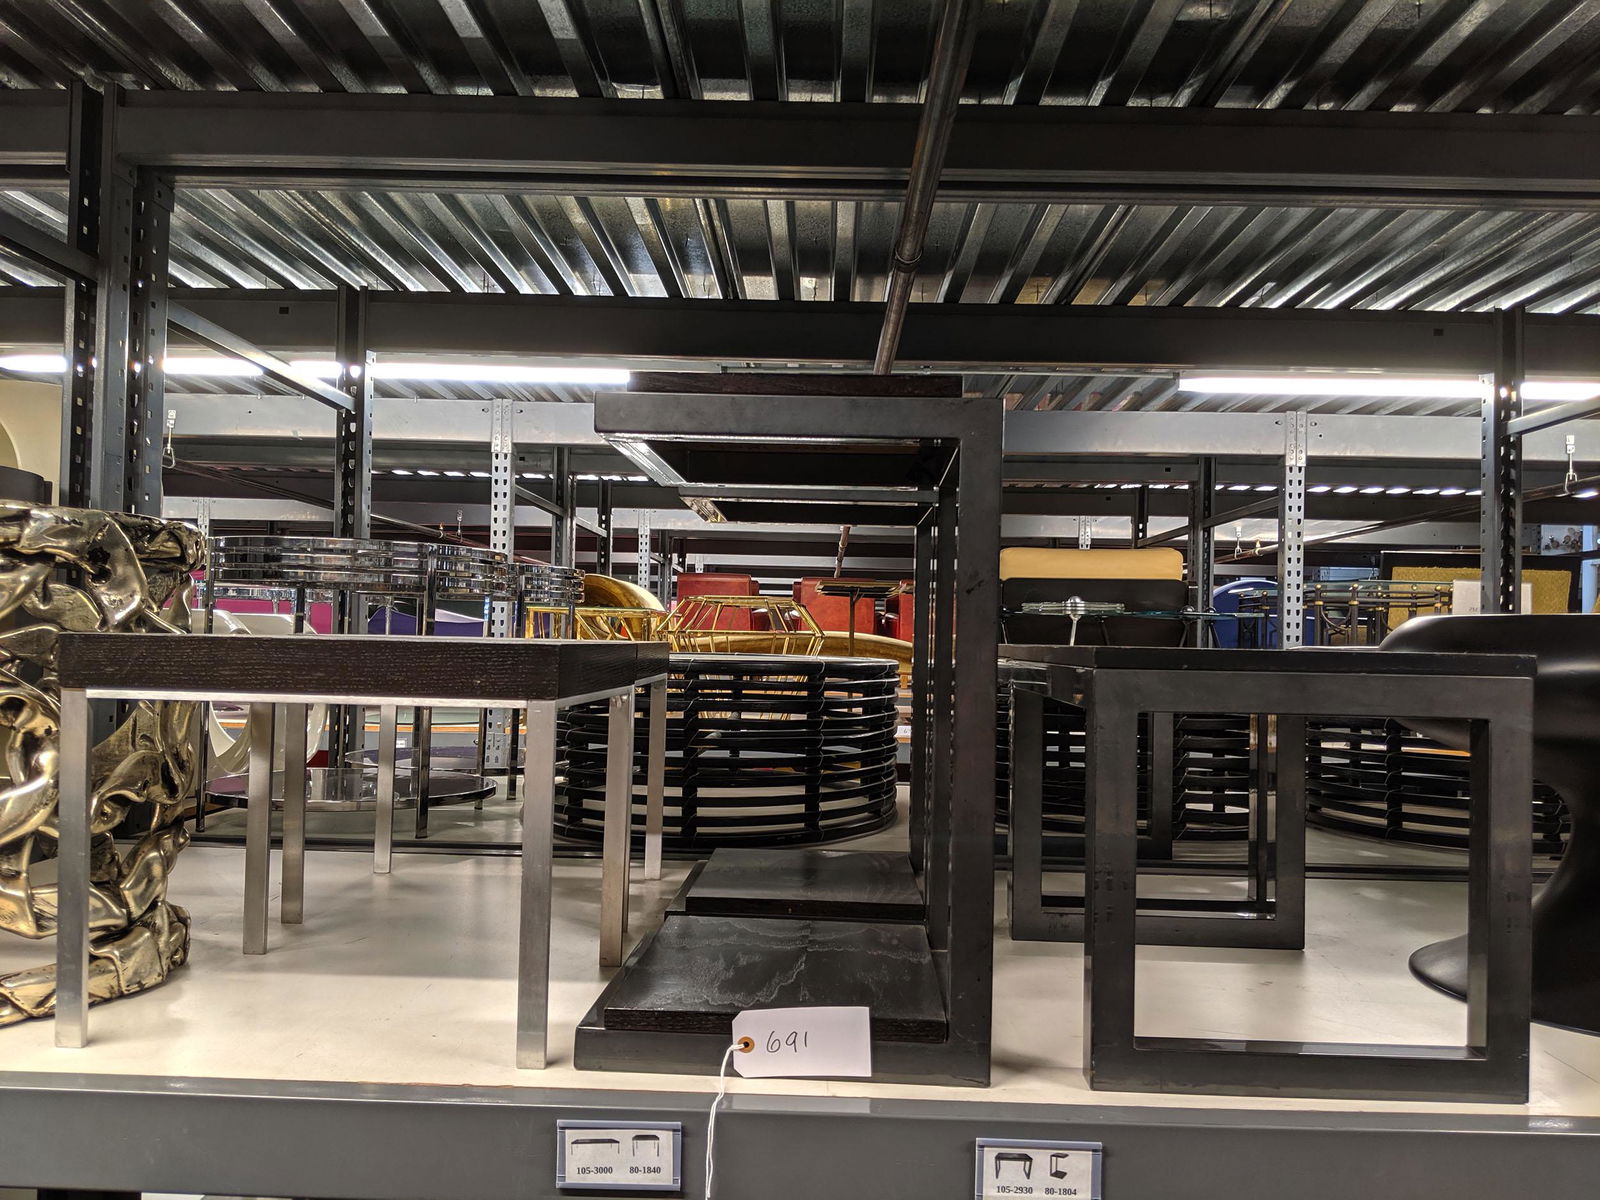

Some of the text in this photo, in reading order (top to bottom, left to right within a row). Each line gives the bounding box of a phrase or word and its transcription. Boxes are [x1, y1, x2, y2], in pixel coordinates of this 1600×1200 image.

[766, 1030, 808, 1053] 691
[576, 1165, 661, 1175] 105-3000 80-1840
[996, 1185, 1077, 1196] 105-2930 80-1804
